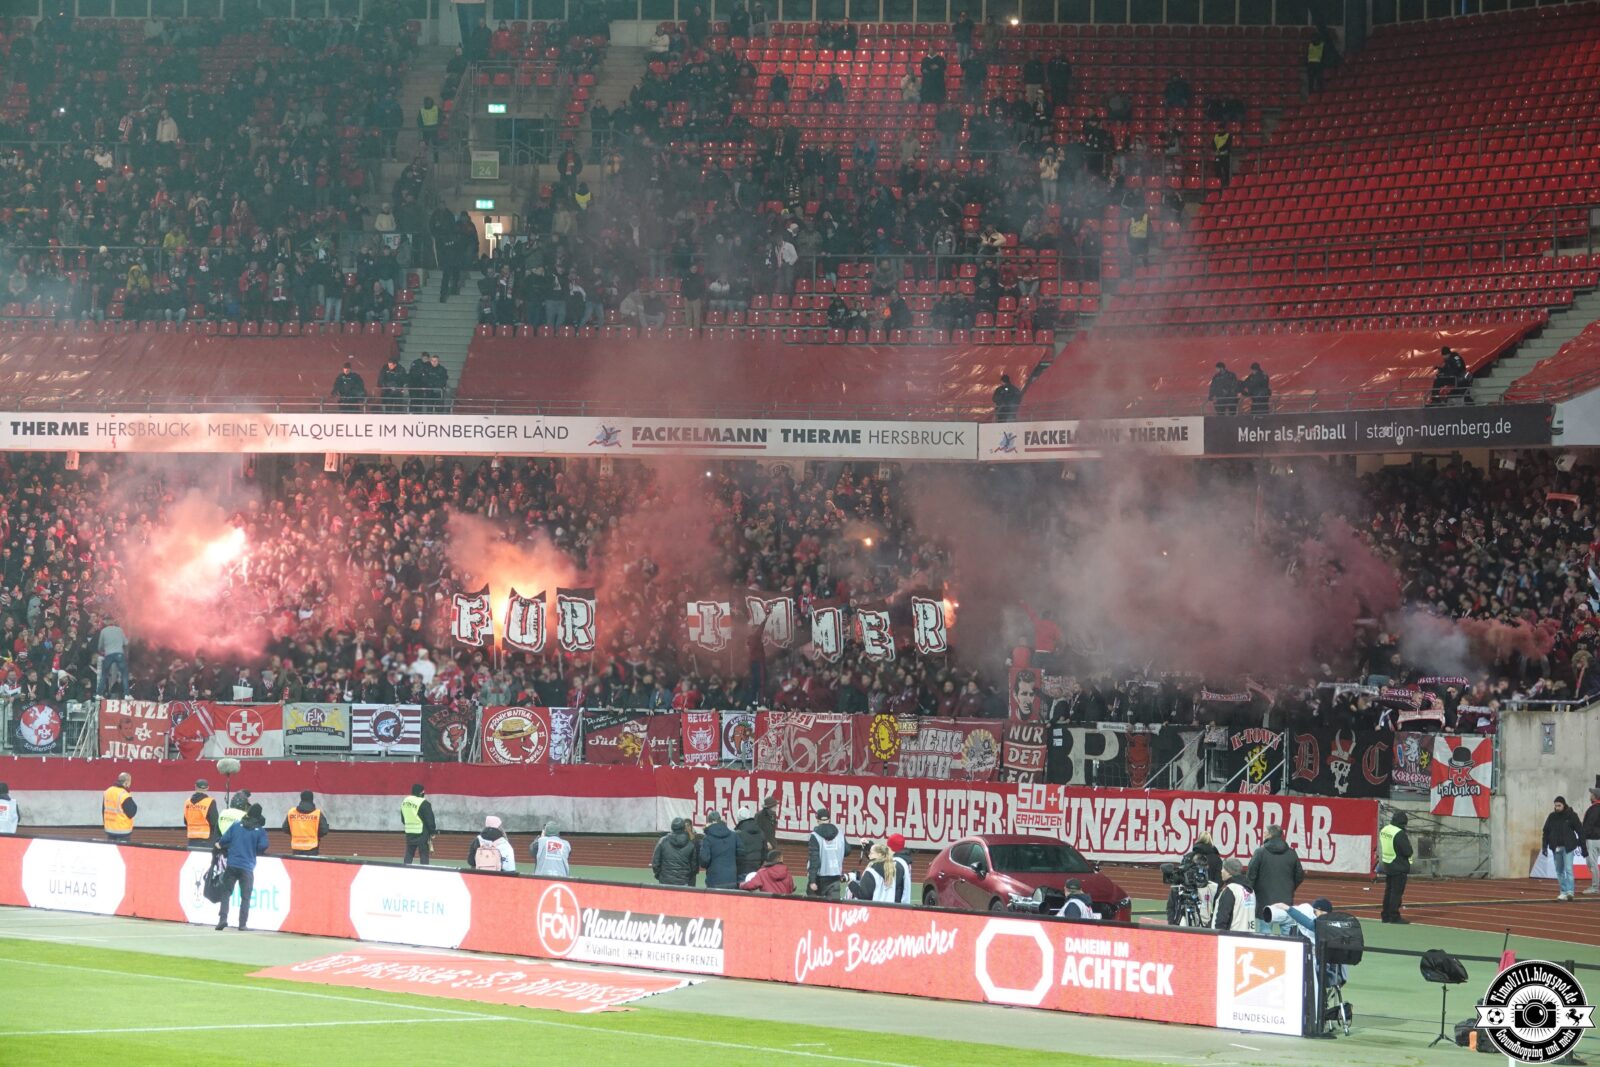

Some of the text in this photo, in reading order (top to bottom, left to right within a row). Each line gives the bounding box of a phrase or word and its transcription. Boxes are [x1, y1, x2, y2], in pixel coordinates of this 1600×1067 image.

[10, 421, 569, 440] THERME HERSBRUCK MEINE VITALQUELLE IM NÜRNBERGER LAND
[631, 427, 965, 446] FACKELMANN THERME HERSBRUCK
[1129, 426, 1189, 443] THERME
[1237, 423, 1347, 443] Mehr als Fußball
[1366, 419, 1512, 445] stadion-nuernberg.de
[105, 699, 169, 720] BETZE
[687, 713, 713, 723] BETZE
[588, 735, 618, 746] Süd
[1009, 725, 1044, 744] NUR
[1230, 727, 1281, 751] K-TOWN
[101, 740, 165, 760] JUNGS
[224, 747, 264, 756] LAUTERTAL
[685, 752, 719, 763] SUPPORTERS
[1007, 747, 1042, 766] DER
[693, 777, 750, 827] 1.FC
[1017, 783, 1065, 811] 50+1
[1015, 813, 1061, 827] ERHALTEN
[49, 879, 97, 898] ULHAAS
[552, 888, 564, 913] 1.
[541, 912, 575, 940] FCN
[582, 907, 723, 950] Handwerker Club
[592, 944, 620, 957] Vaillant
[795, 920, 958, 982] Club-Bessermacher
[1065, 937, 1129, 958] DAHEIM IM
[1061, 956, 1174, 996] ACHTECK
[1233, 1011, 1286, 1025] BUNDESLIGA
